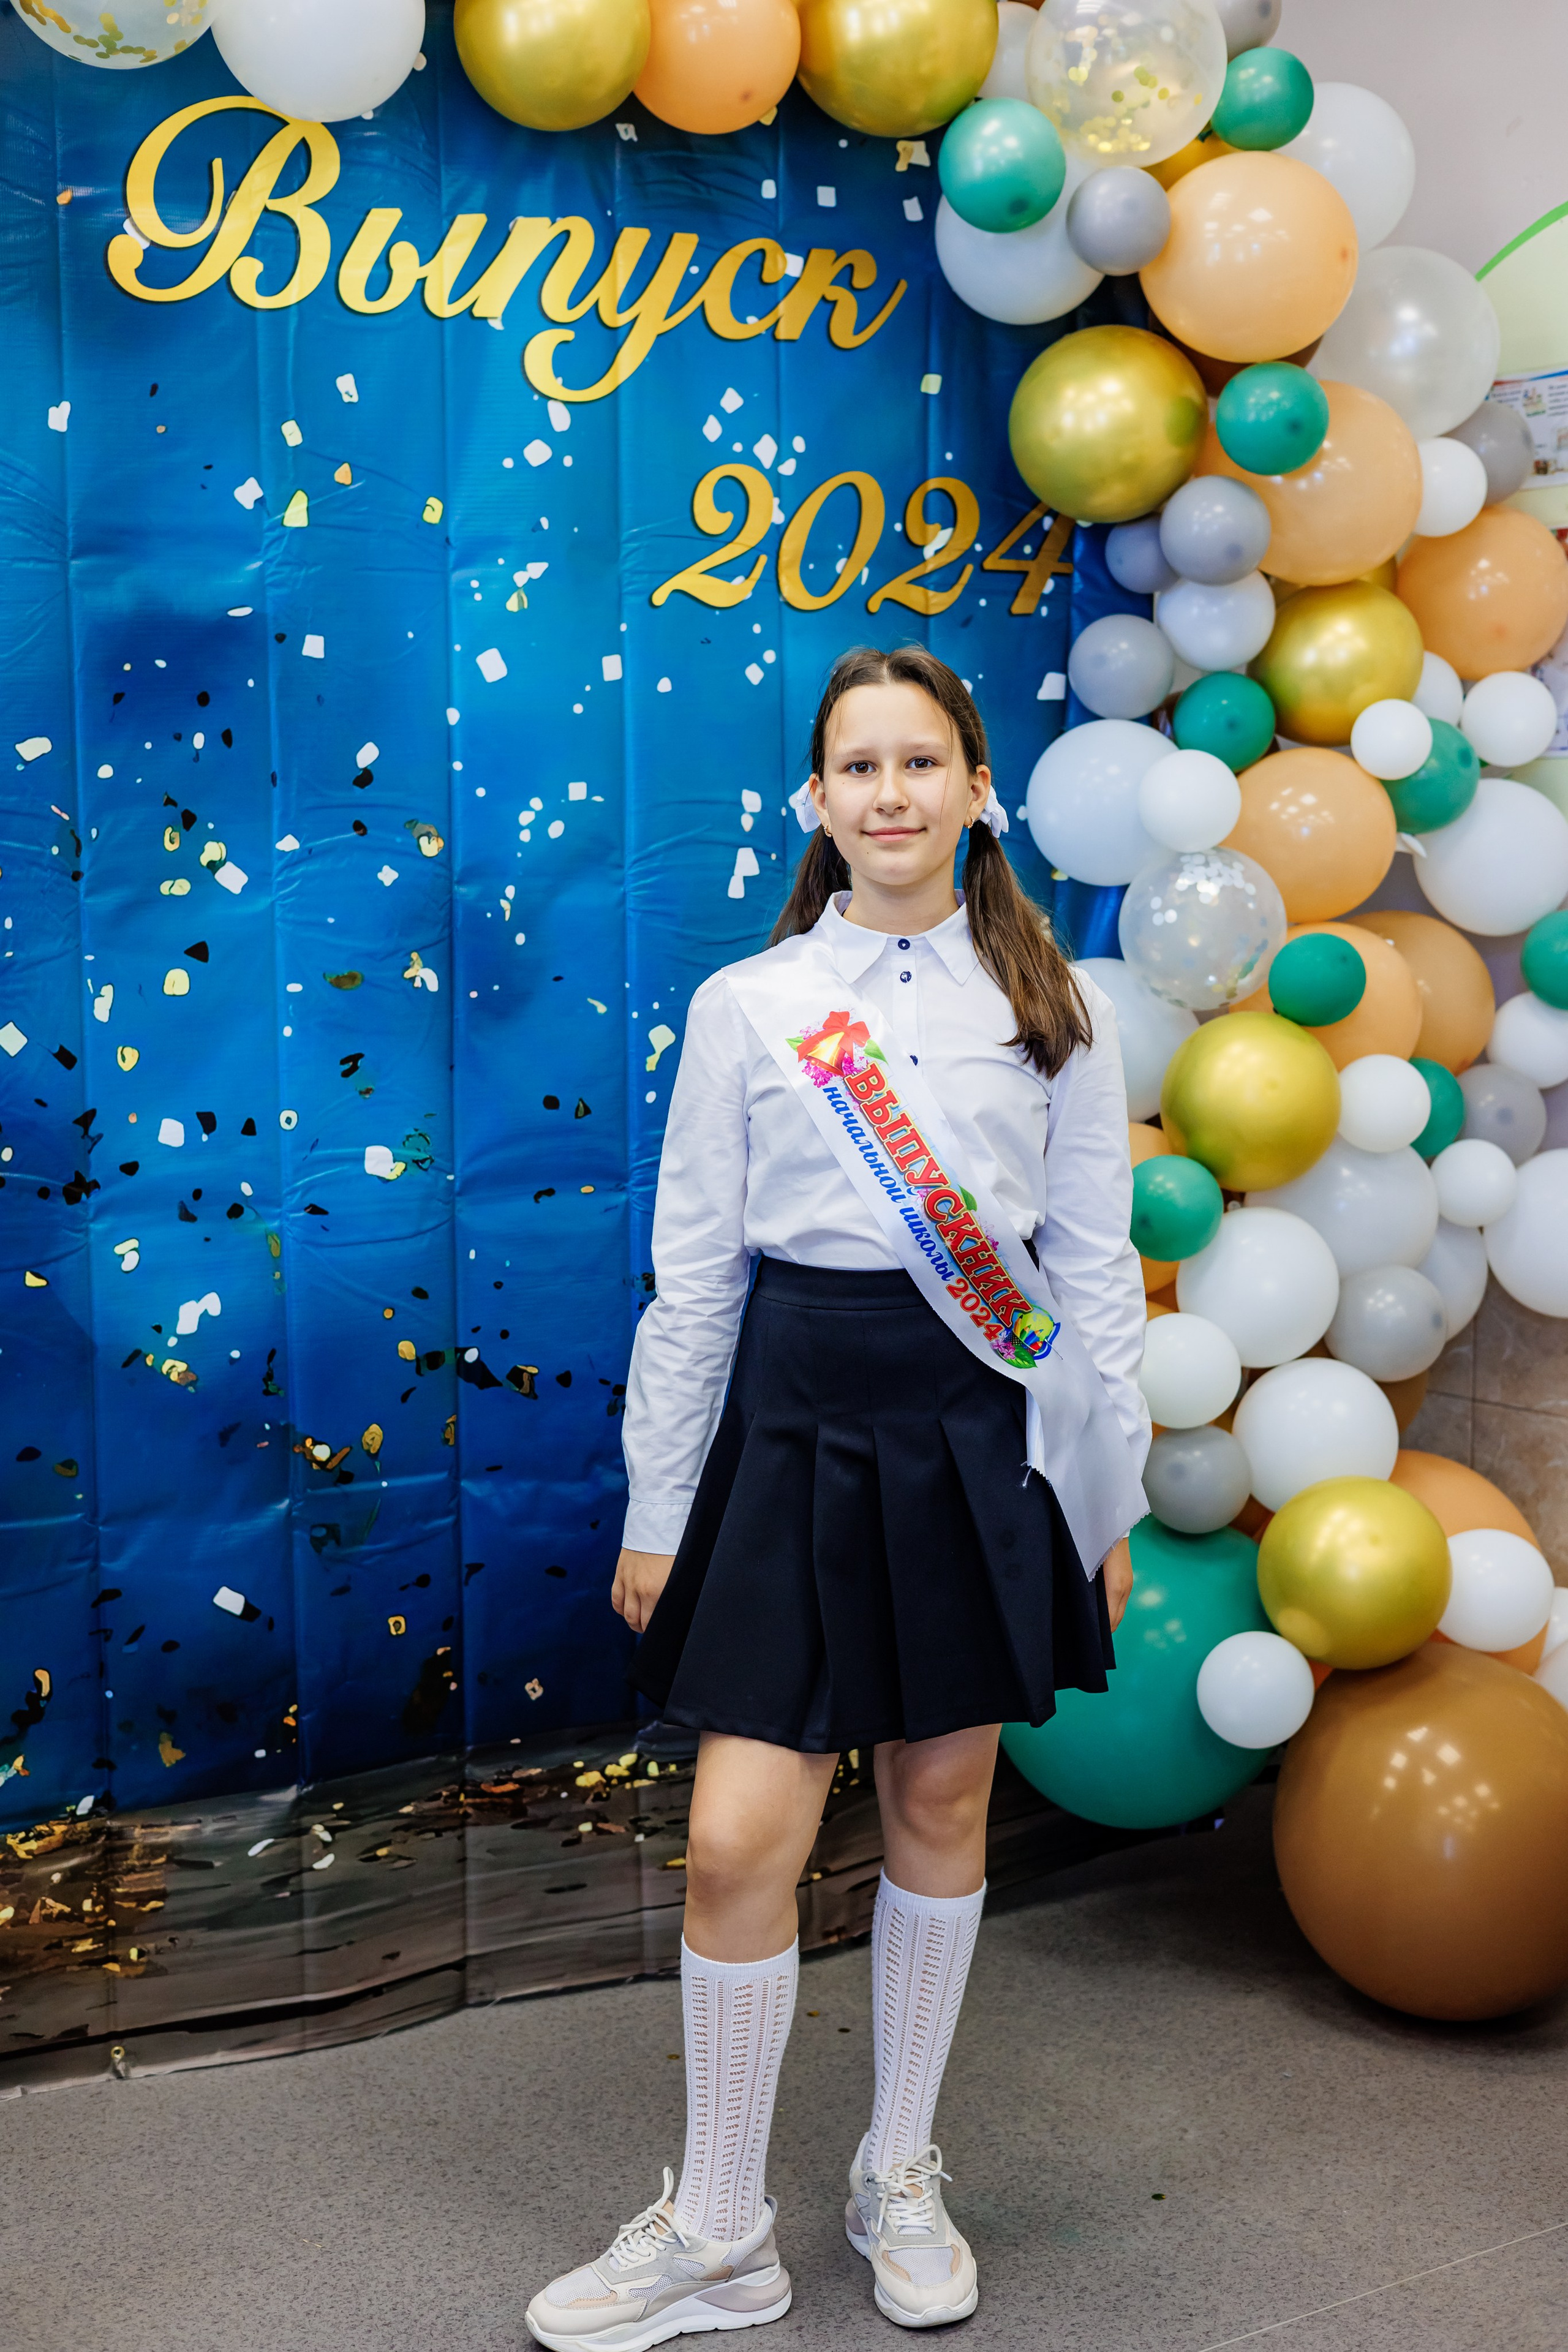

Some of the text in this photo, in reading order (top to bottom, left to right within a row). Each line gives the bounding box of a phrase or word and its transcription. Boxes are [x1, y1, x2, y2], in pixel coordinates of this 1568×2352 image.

[107, 96, 908, 402] Выпуск
[651, 463, 1076, 615] 2024
[823, 1087, 1004, 1341] начальной школы 2024
[843, 1061, 1033, 1329] ВЫПУСКНИК
